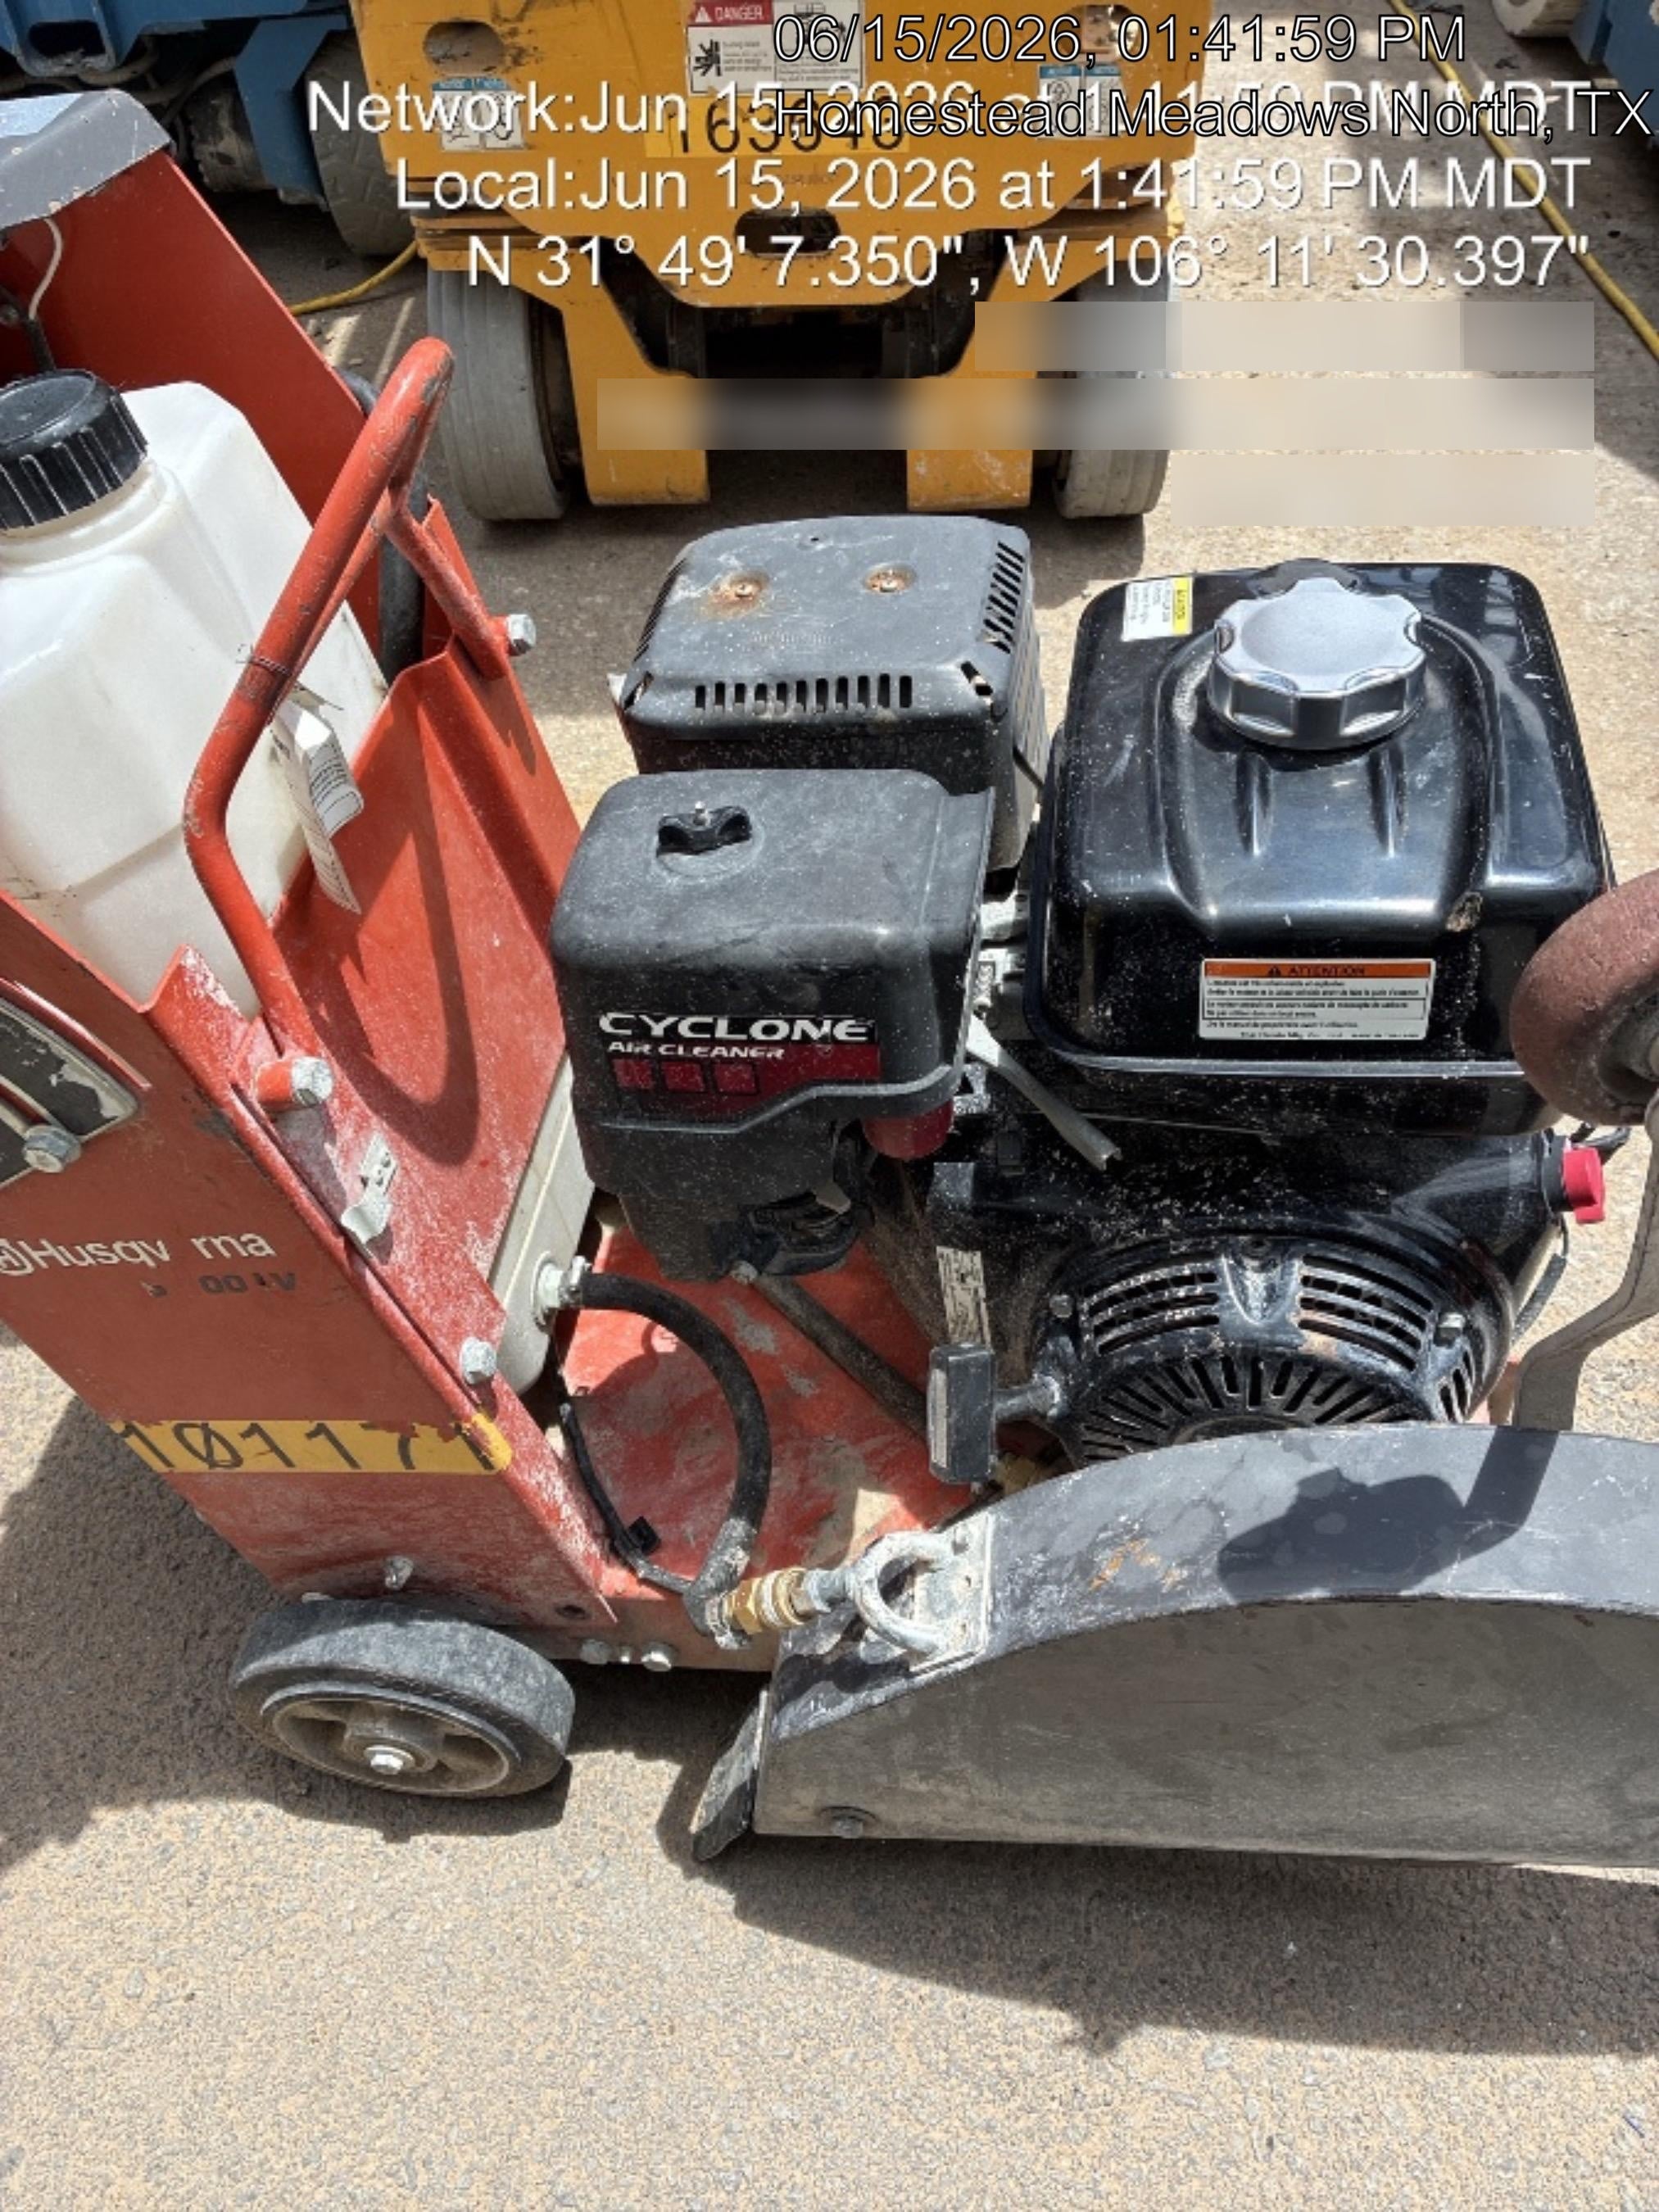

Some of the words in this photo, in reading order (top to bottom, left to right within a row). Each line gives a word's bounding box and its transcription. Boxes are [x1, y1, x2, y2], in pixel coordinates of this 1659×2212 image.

[714, 7, 764, 21] DANGER
[599, 1013, 868, 1041] CYCLONE
[608, 1041, 650, 1054] AIR
[659, 1043, 786, 1059] CLEANER
[18, 1233, 277, 1269] Husqvrna
